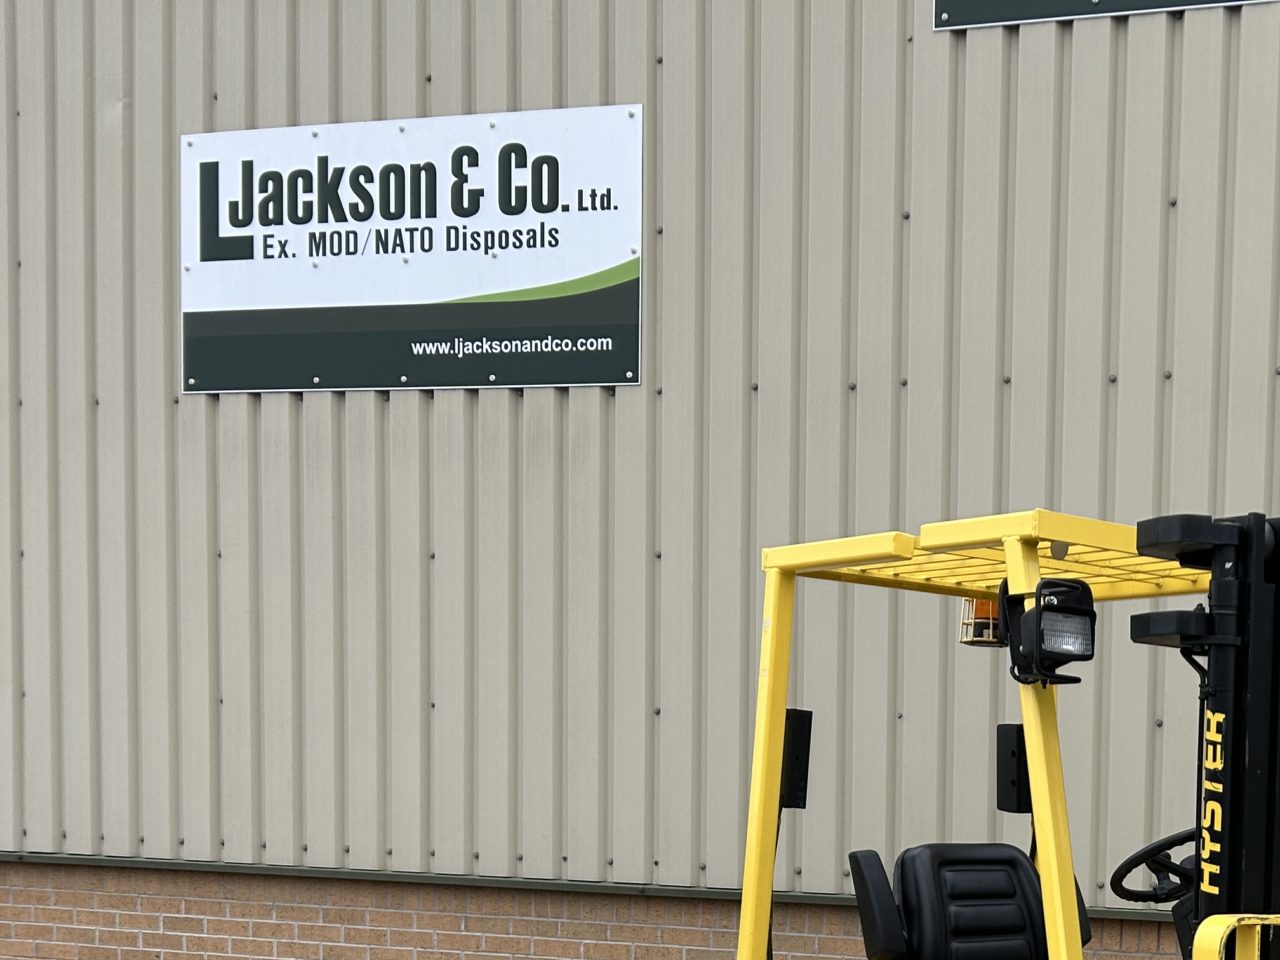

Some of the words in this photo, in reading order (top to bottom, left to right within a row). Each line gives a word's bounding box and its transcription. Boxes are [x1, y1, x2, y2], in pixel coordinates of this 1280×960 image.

[451, 145, 484, 218] &
[498, 142, 570, 215] Co.
[577, 187, 618, 212] Ltd.
[263, 234, 296, 259] Ex.
[308, 225, 434, 257] MOD/NATO
[446, 221, 559, 255] Disposals
[411, 336, 613, 358] www.ljacksonandco.com
[1200, 710, 1226, 895] HYSTER
